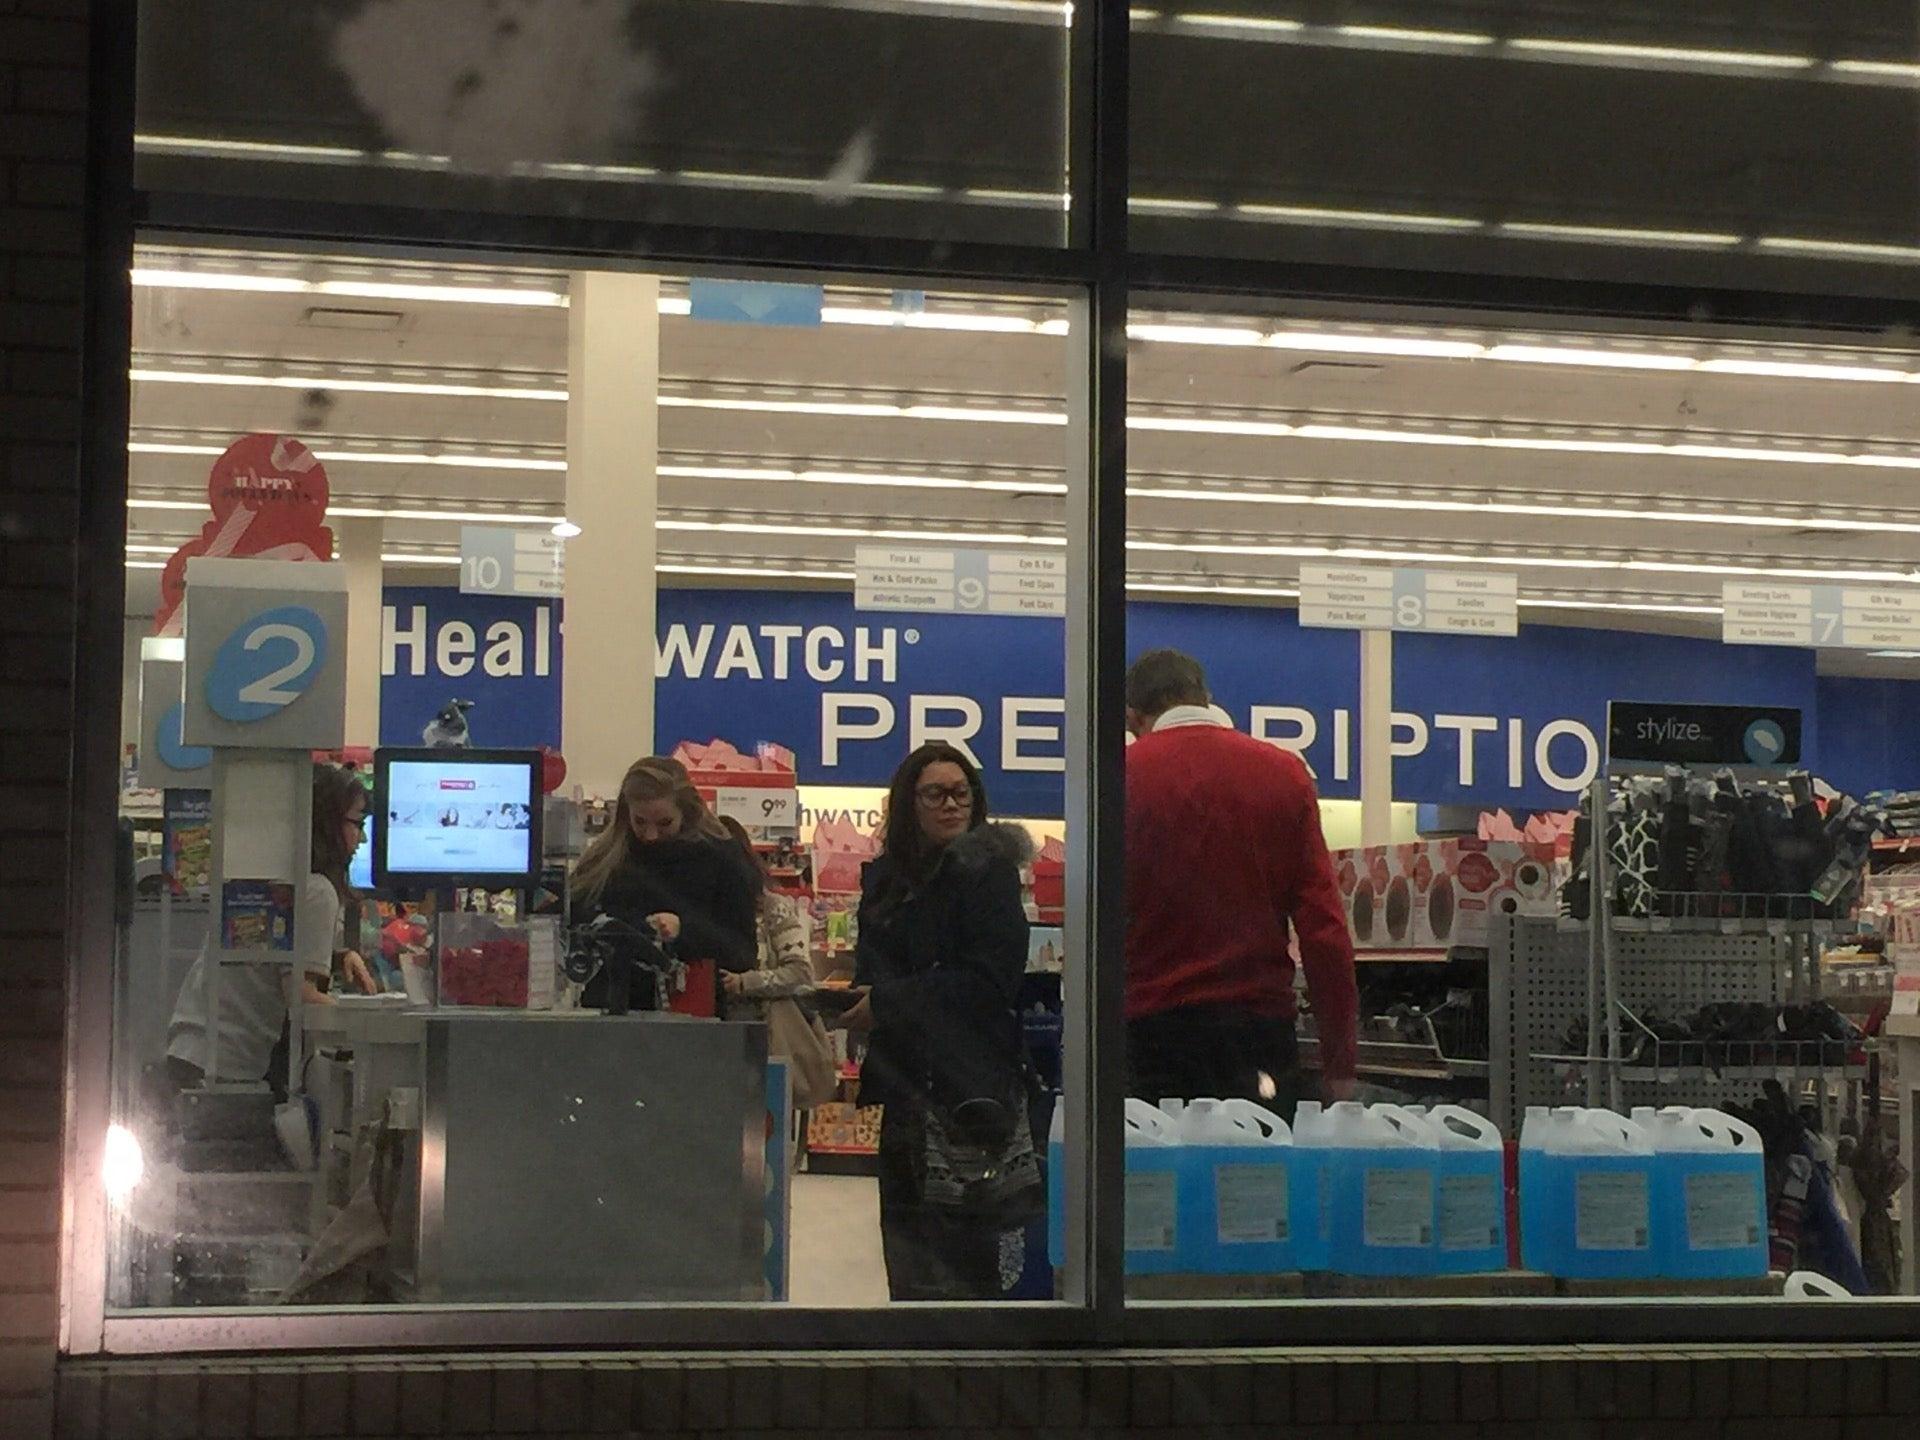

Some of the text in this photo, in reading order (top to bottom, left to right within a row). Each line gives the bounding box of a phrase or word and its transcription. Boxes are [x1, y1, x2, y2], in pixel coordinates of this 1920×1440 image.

[233, 471, 294, 490] HAPPY
[467, 555, 502, 590] 10
[1019, 558, 1033, 569] Eye
[957, 576, 985, 609] 9
[1397, 594, 1423, 627] 8
[1814, 612, 1840, 643] 7
[238, 622, 315, 706] 2
[1637, 717, 1701, 745] stylize
